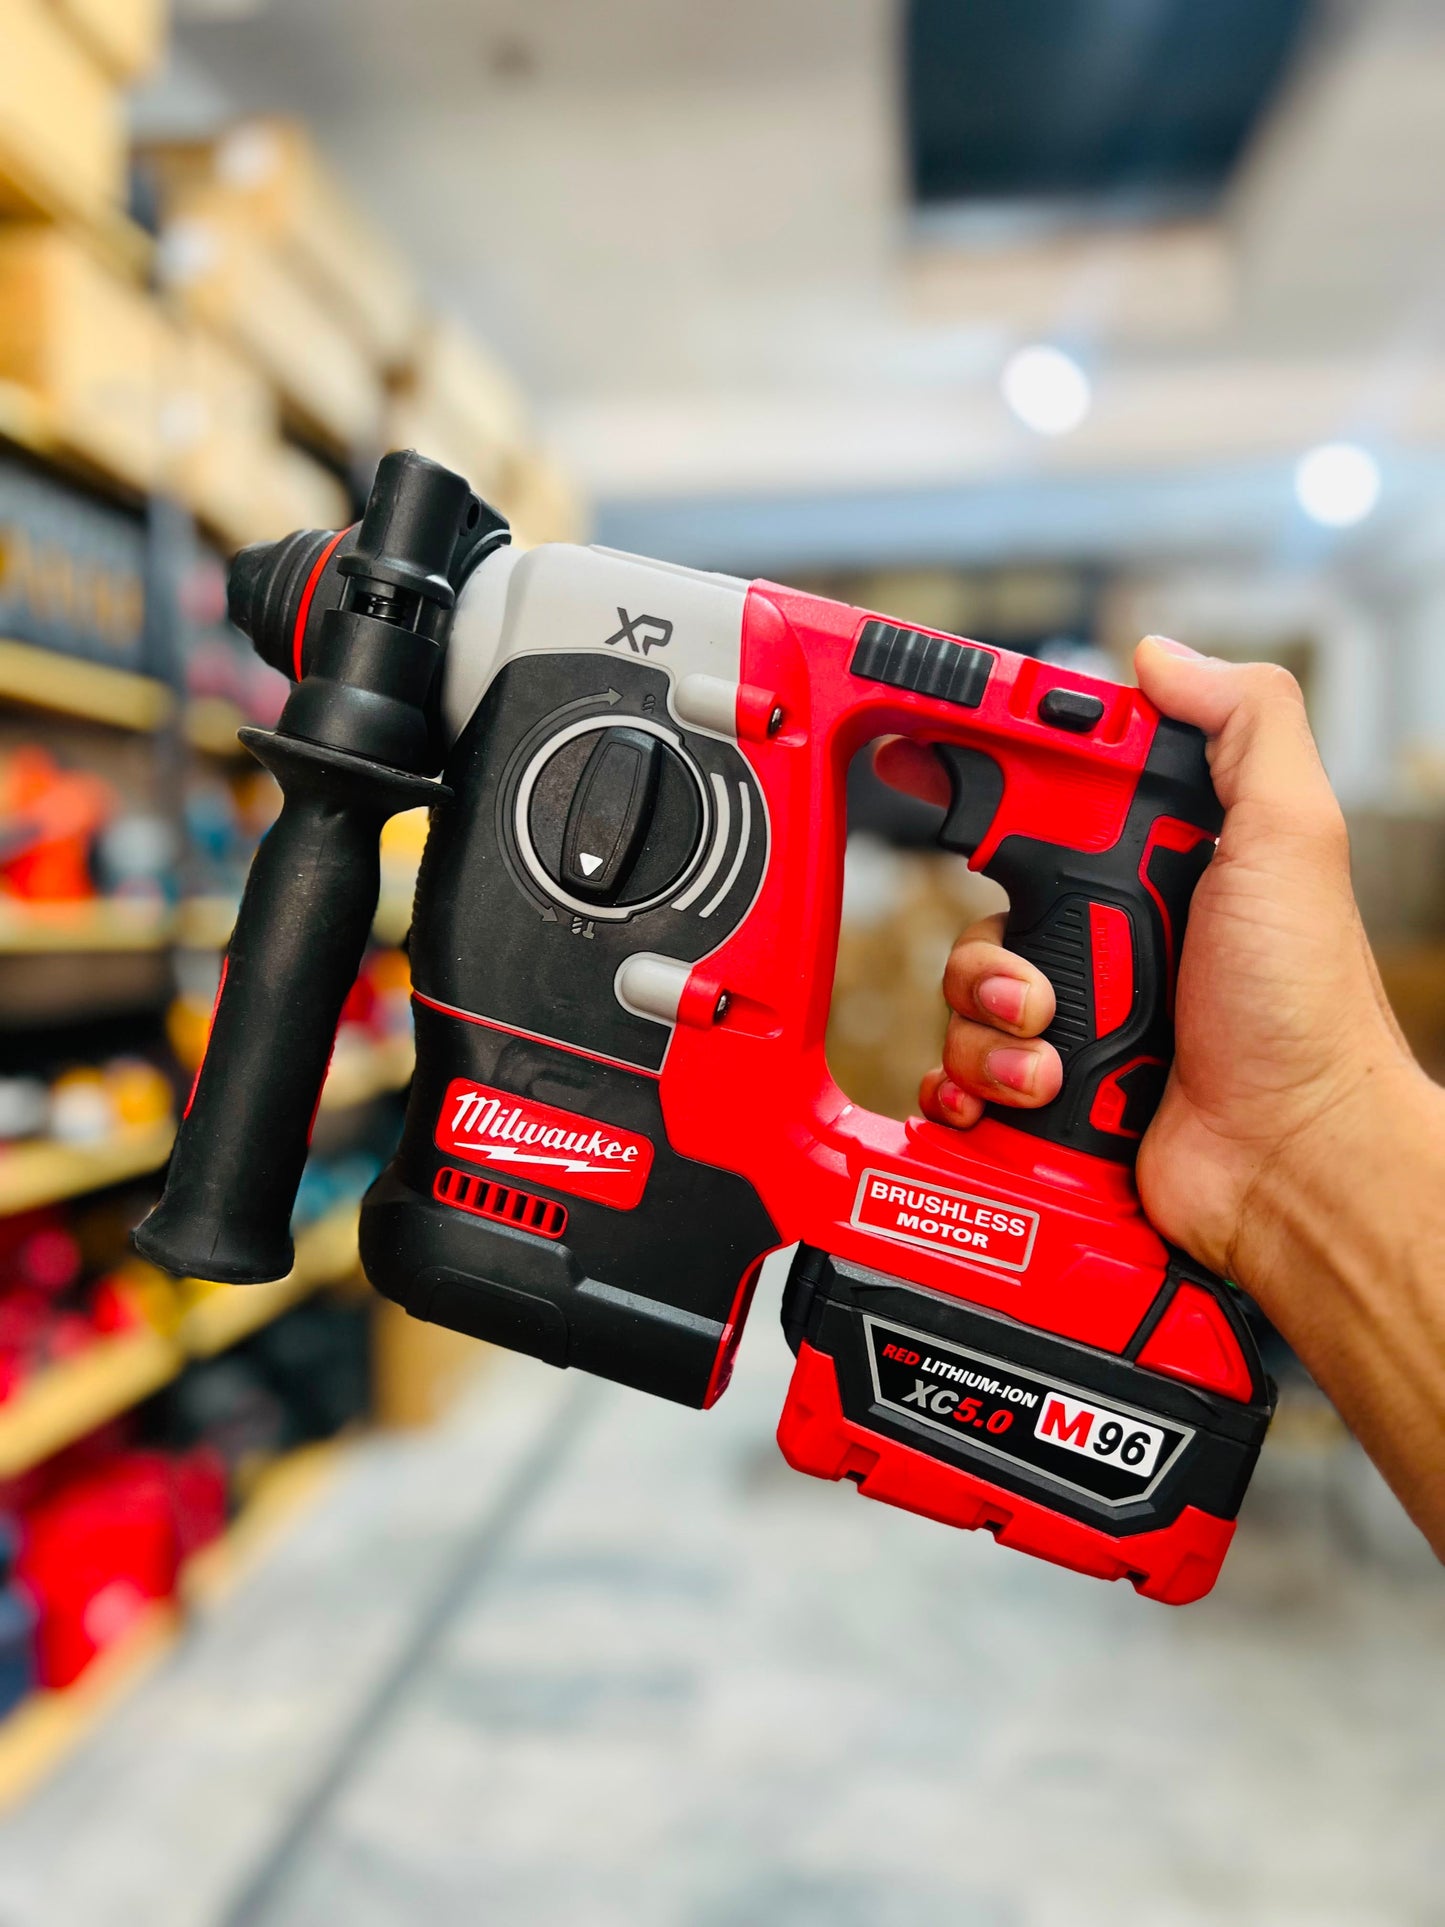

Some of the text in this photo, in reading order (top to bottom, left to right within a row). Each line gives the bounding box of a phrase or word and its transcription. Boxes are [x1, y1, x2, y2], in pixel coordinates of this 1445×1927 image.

[605, 607, 673, 656] XP
[451, 1092, 639, 1162] Milwaukee
[870, 1181, 1026, 1236] BRUSHLESS
[896, 1212, 989, 1248] MOTOR
[882, 1343, 1038, 1408] RED LITHIUM-ION
[902, 1379, 1015, 1435] XC5.0
